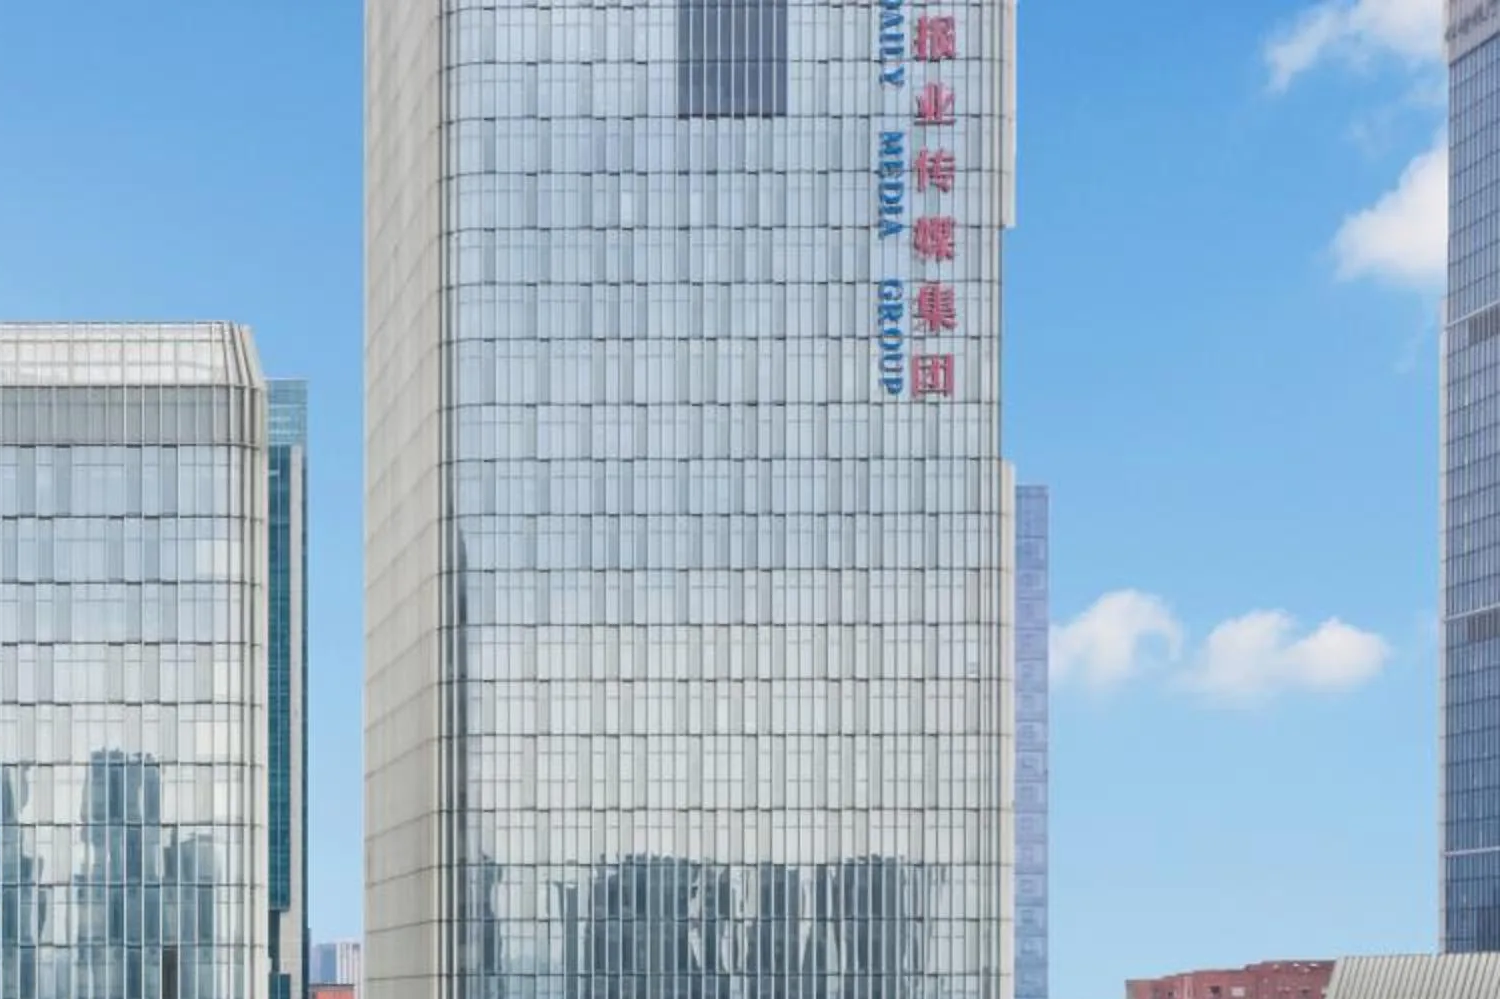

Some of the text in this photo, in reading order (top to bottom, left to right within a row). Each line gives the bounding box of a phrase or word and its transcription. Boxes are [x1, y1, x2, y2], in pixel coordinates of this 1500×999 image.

[878, 131, 904, 239] MEDIA
[911, 14, 956, 398] 报业传媒集团
[878, 279, 904, 396] GROUP
